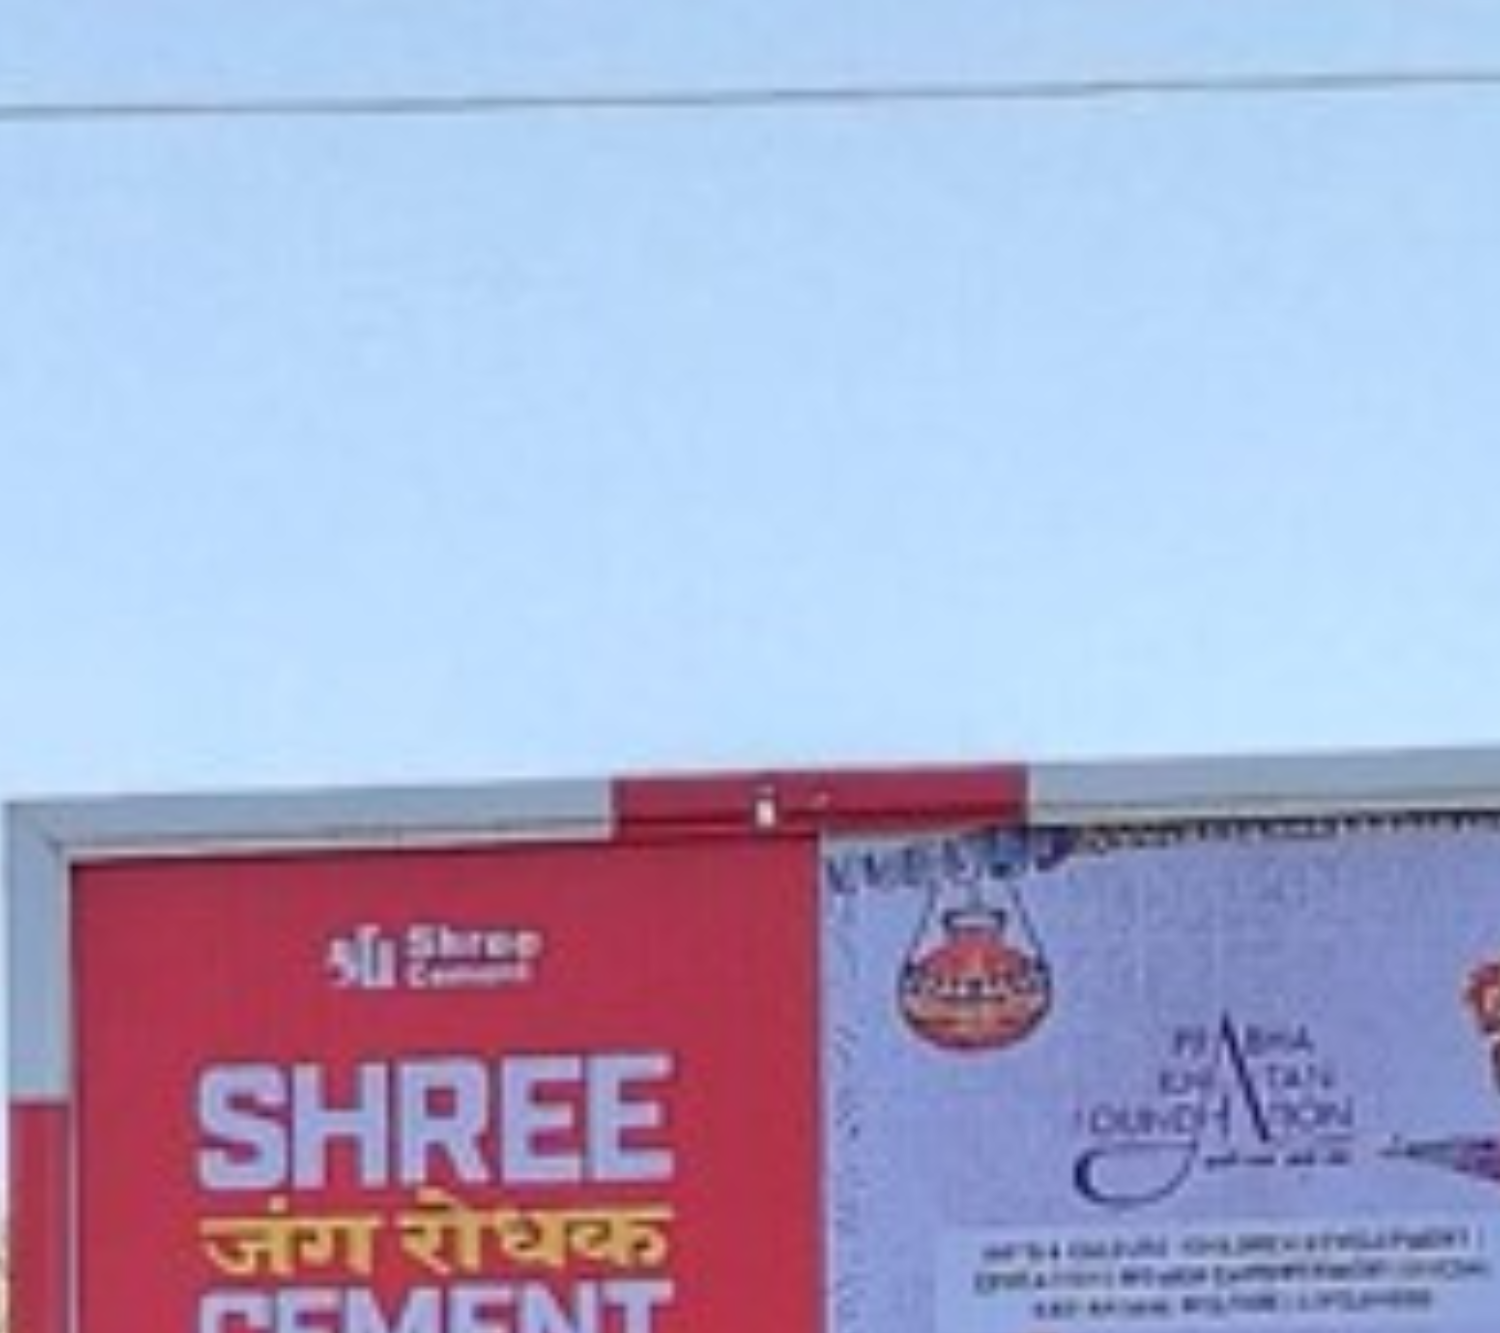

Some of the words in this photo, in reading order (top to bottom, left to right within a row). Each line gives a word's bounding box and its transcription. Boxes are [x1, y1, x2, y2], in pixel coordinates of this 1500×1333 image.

[408, 923, 542, 960] Shree
[198, 1052, 675, 1192] SHREE
[200, 1195, 380, 1275] जंग
[398, 1187, 675, 1275] रोधक
